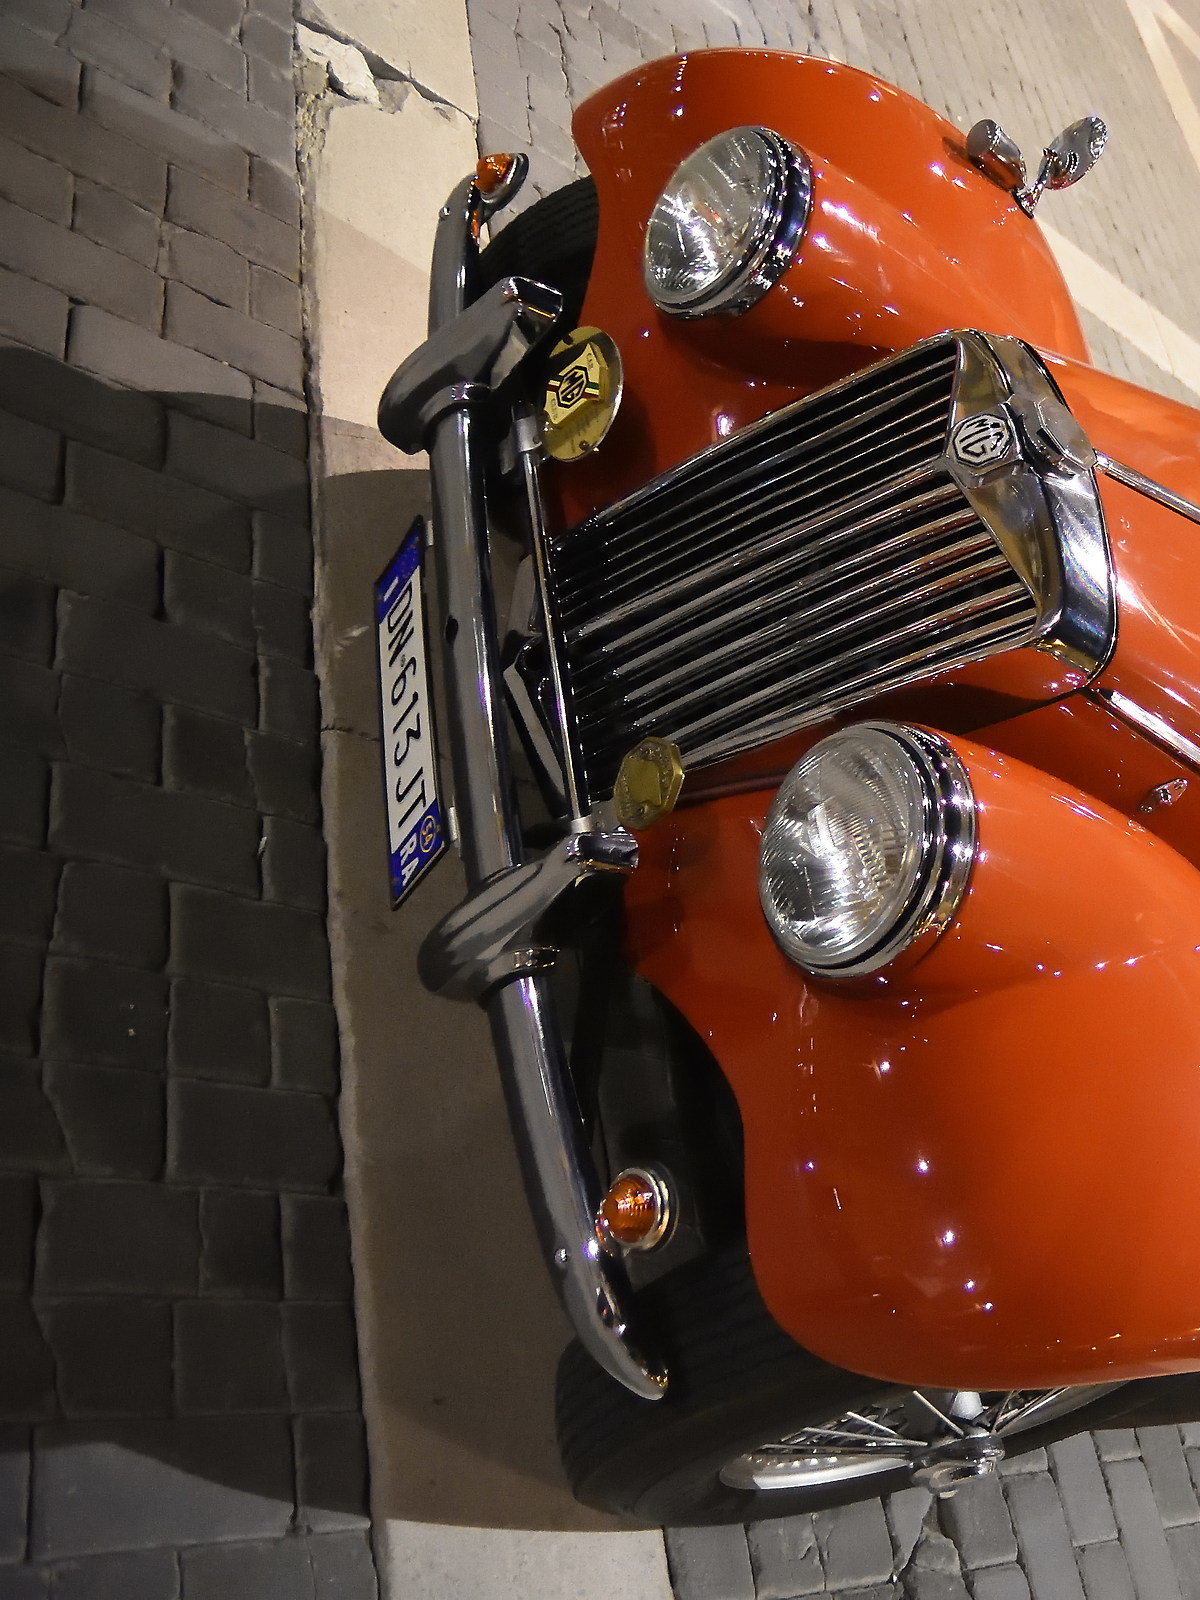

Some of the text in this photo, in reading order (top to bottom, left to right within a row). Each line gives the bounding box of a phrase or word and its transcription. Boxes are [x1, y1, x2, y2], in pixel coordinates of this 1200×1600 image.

[560, 370, 586, 403] MG
[956, 416, 1007, 459] MG
[400, 832, 420, 887] RA
